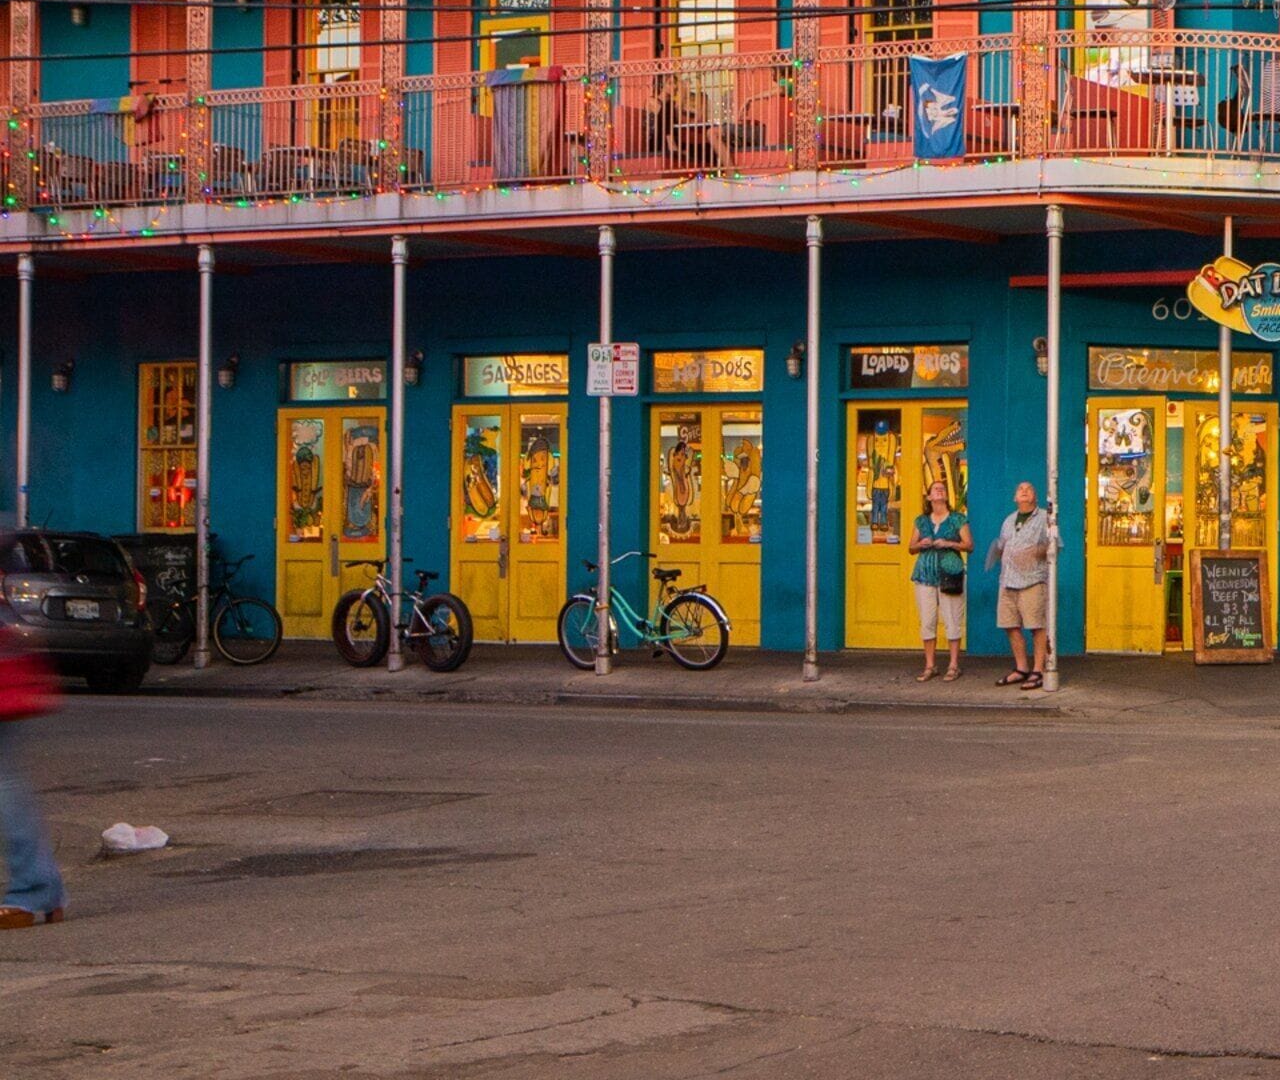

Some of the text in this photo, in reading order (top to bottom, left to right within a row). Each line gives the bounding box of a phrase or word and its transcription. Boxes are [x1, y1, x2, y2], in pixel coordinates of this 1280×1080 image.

[1220, 272, 1266, 309] DAT
[1152, 297, 1209, 320] 60
[482, 362, 562, 386] SAUSAGES
[672, 358, 707, 383] HOT
[861, 354, 910, 376] LOADED
[335, 367, 383, 387] BEERS
[1211, 591, 1239, 602] BEEF
